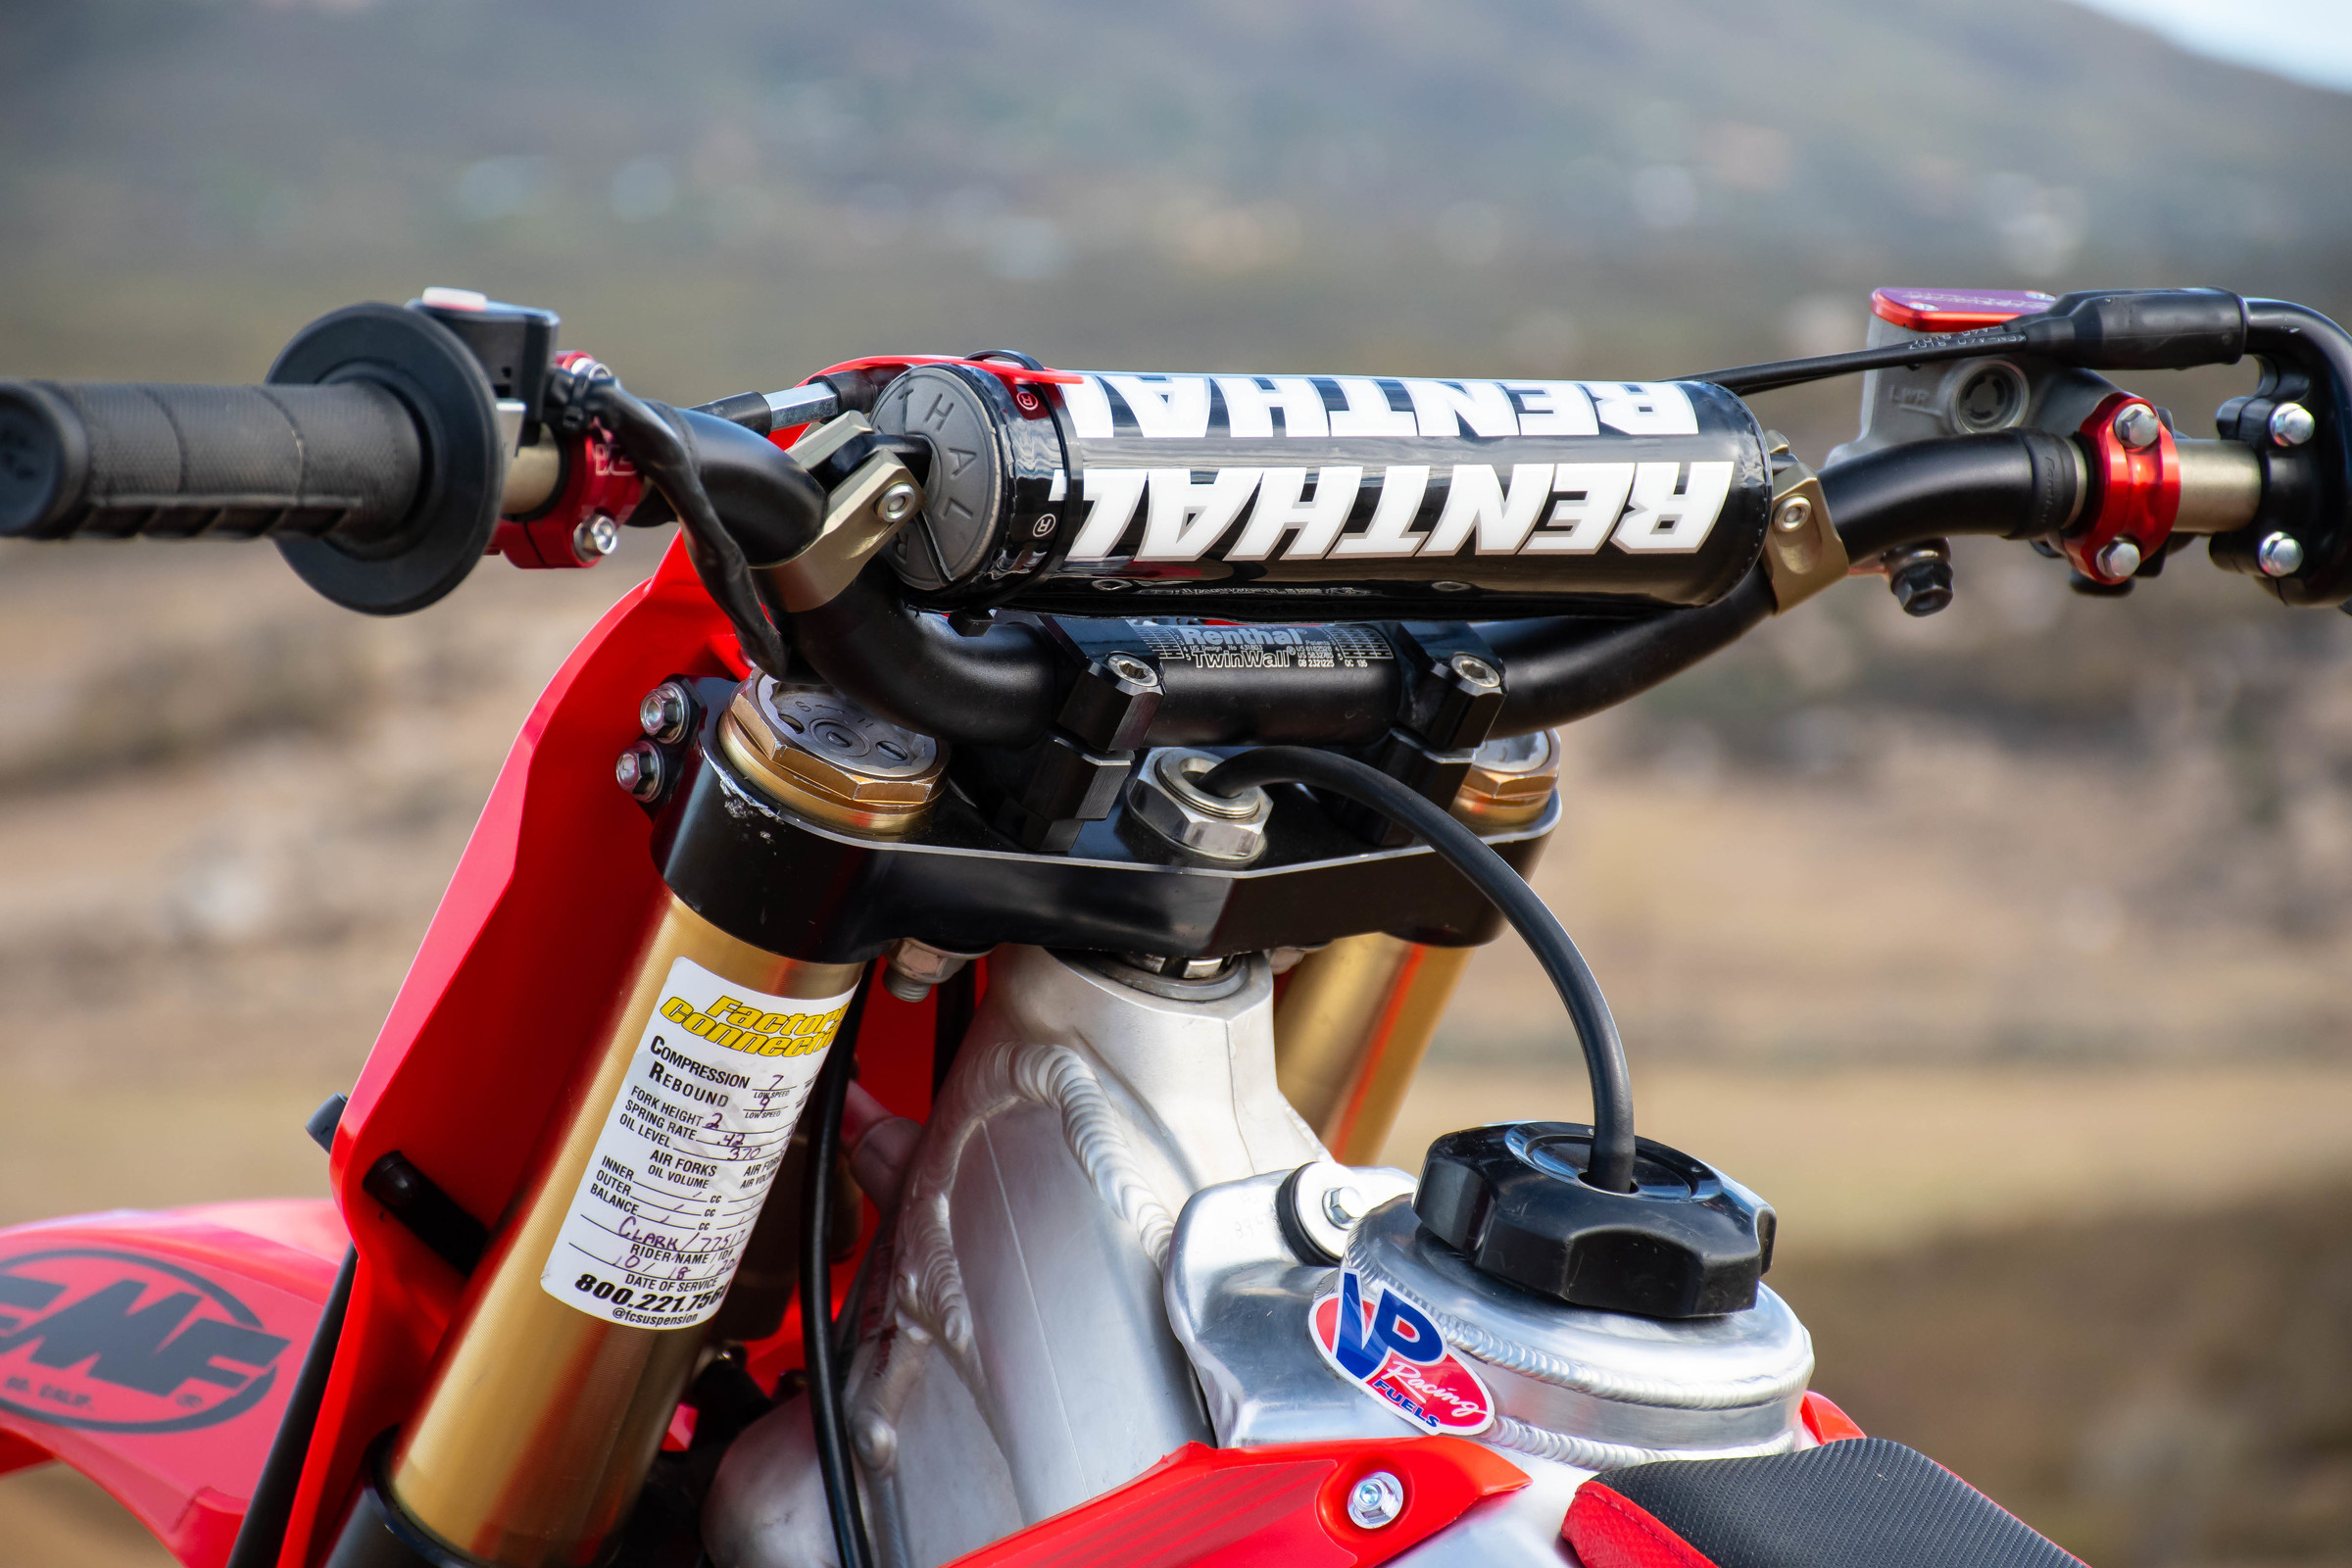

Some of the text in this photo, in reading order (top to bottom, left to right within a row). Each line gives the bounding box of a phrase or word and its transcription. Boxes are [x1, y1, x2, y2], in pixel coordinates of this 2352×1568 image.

[1048, 462, 1735, 562] RENTHAL
[1178, 627, 1303, 645] Renthal
[1192, 650, 1291, 668] TwinWall
[648, 1060, 729, 1107] REBOUND
[769, 1074, 784, 1091] 7
[770, 1090, 790, 1099] SPEED
[630, 1085, 704, 1127] FORK HEIGHT
[761, 1109, 781, 1119] SPEED
[619, 1113, 670, 1148] OIL LEVEL
[625, 1099, 697, 1141] SPRING RATE
[705, 1112, 723, 1129] 2
[601, 1154, 635, 1182] INNER
[648, 1164, 710, 1189] OIL VOLUME
[649, 1150, 717, 1177] AIR FORKS
[743, 1163, 761, 1177] AIR
[596, 1169, 632, 1197] OUTER
[739, 1178, 755, 1189] AIR
[590, 1183, 639, 1216] BALANCE
[618, 1215, 679, 1251] CLARK
[630, 1244, 671, 1262] RIDER
[674, 1253, 710, 1264] NAME
[624, 1273, 719, 1293] DATE OF SERVICE
[612, 1307, 699, 1327] @fcsuspension
[1335, 1271, 1444, 1381] VP
[1381, 1359, 1489, 1418] Racing
[1373, 1380, 1441, 1428] FUELS
